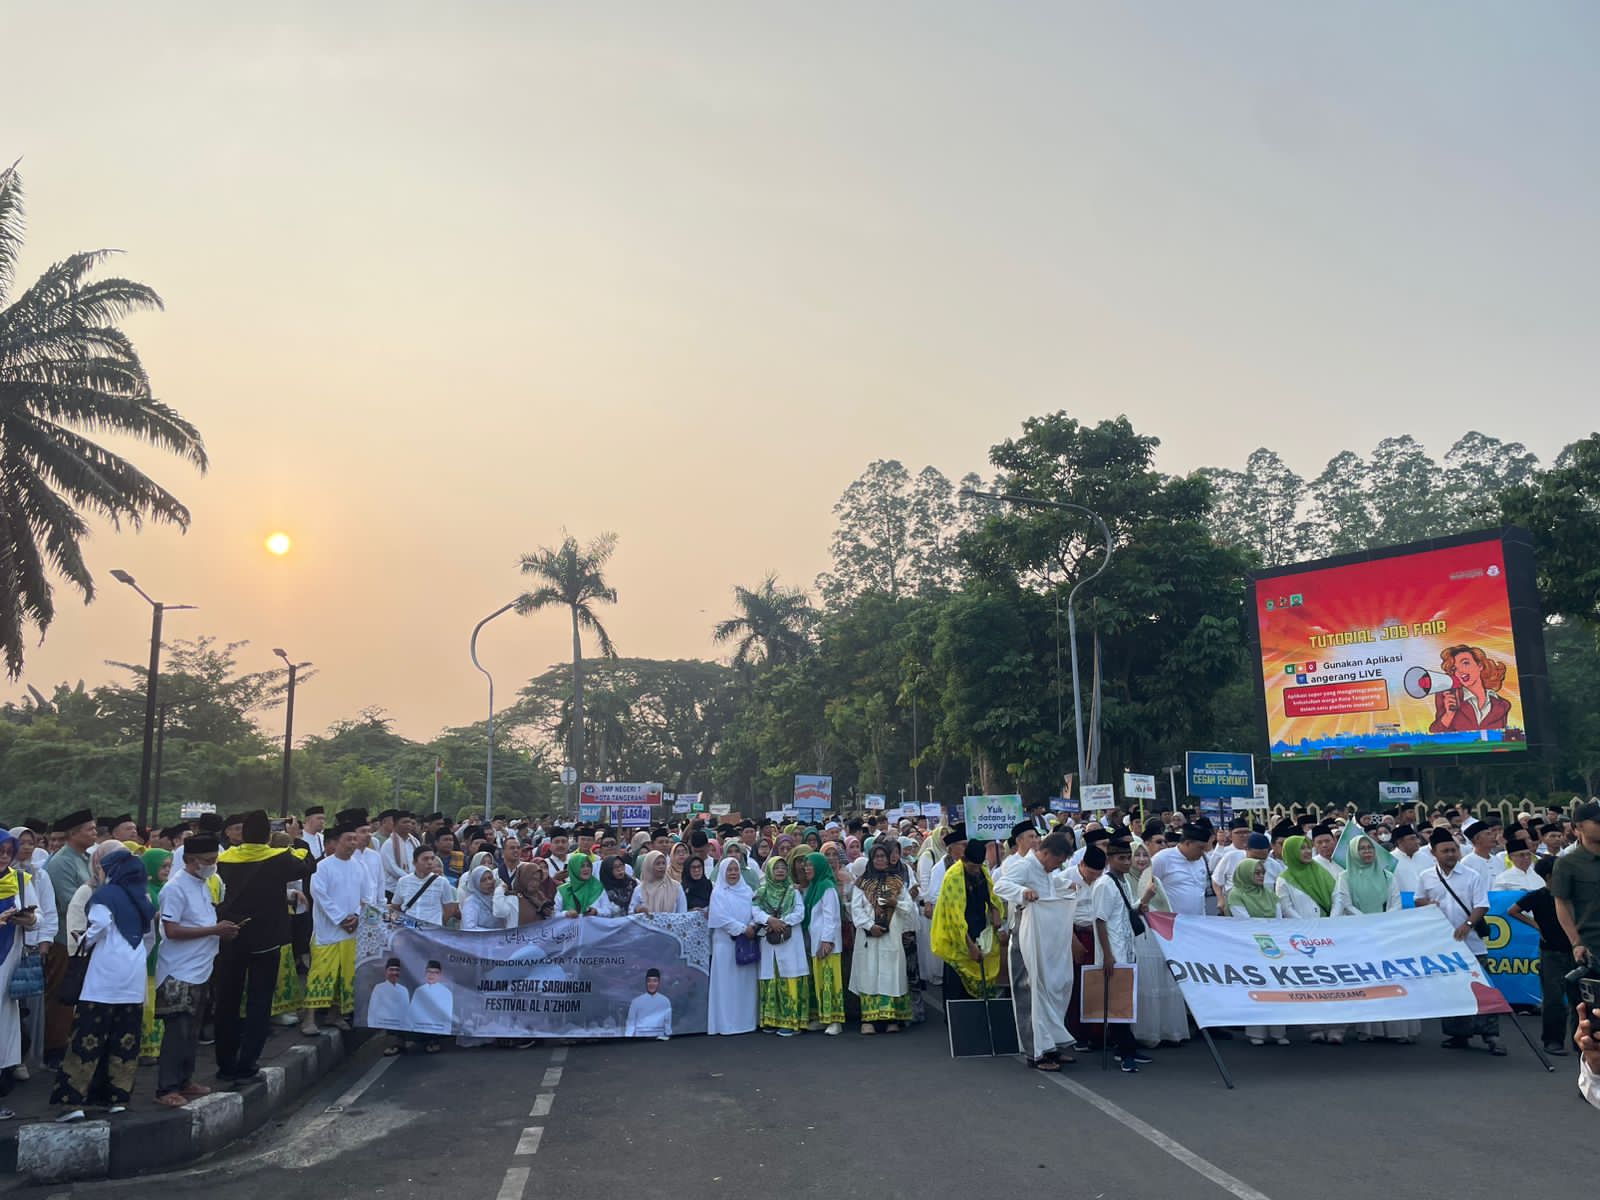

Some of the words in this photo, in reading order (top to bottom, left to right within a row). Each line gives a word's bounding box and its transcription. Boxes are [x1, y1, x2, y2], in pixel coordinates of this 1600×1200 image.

[1309, 630, 1376, 648] TUTORIAL
[1380, 625, 1409, 641] JOB
[1413, 620, 1448, 638] FAIR
[1323, 659, 1363, 670] Gunakan
[1365, 654, 1403, 668] Aplikasi
[1359, 669, 1382, 680] LIVE
[1387, 786, 1412, 794] SETDA
[986, 805, 1003, 814] Yuk
[978, 814, 1006, 823] datang
[566, 955, 625, 967] TANGERANG
[1166, 959, 1266, 987] DINAS
[1270, 952, 1470, 986] KESEHATAN
[477, 979, 509, 993] JALAN
[510, 979, 540, 993] SEHAT
[541, 979, 592, 994] SARUNGAN
[1288, 991, 1312, 1000] KOTA
[1312, 989, 1367, 1000] TANGERANG
[485, 998, 527, 1012] FESTIVAL
[529, 999, 541, 1012] AL
